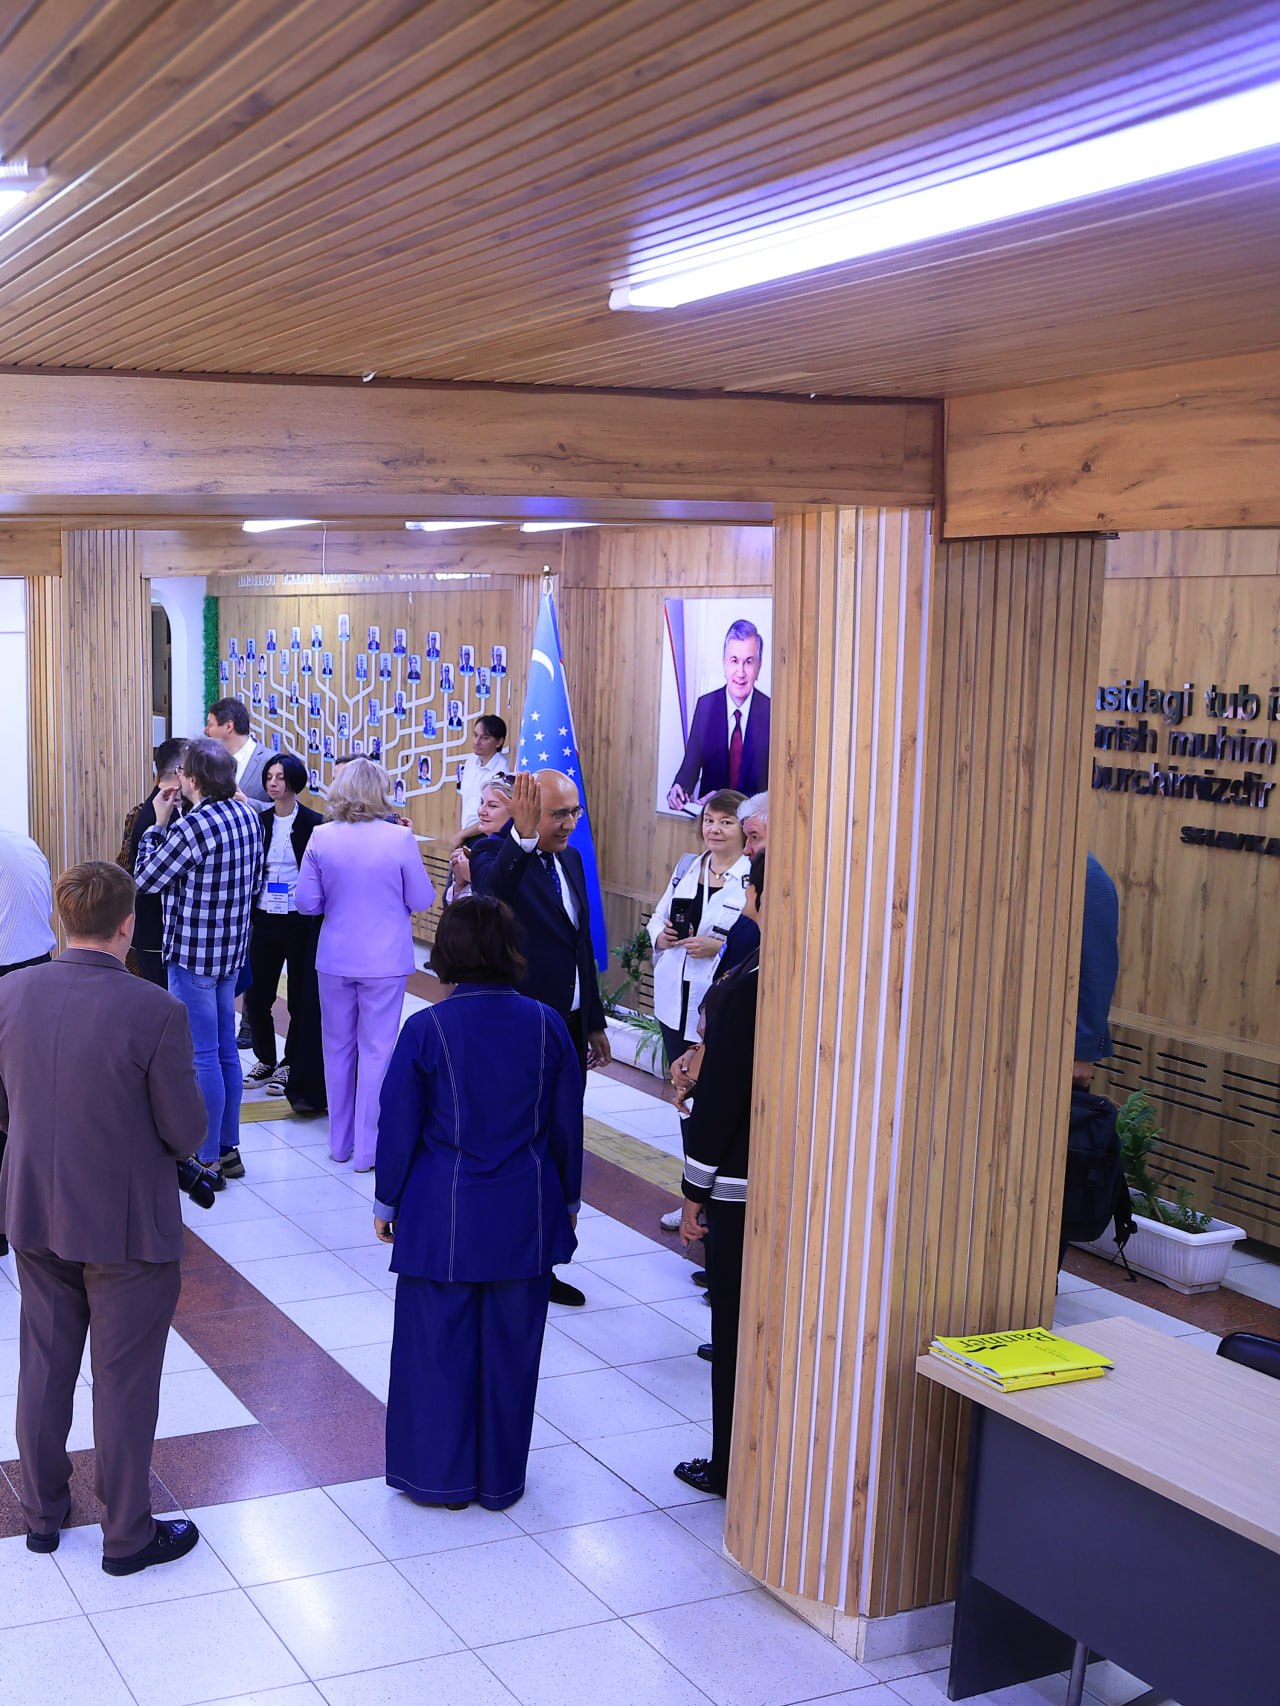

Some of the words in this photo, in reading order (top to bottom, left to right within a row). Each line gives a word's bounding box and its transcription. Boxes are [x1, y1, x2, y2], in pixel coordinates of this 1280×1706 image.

[1205, 684, 1261, 720] tub
[1169, 725, 1277, 765] muhim
[958, 1332, 1058, 1349] Banner
